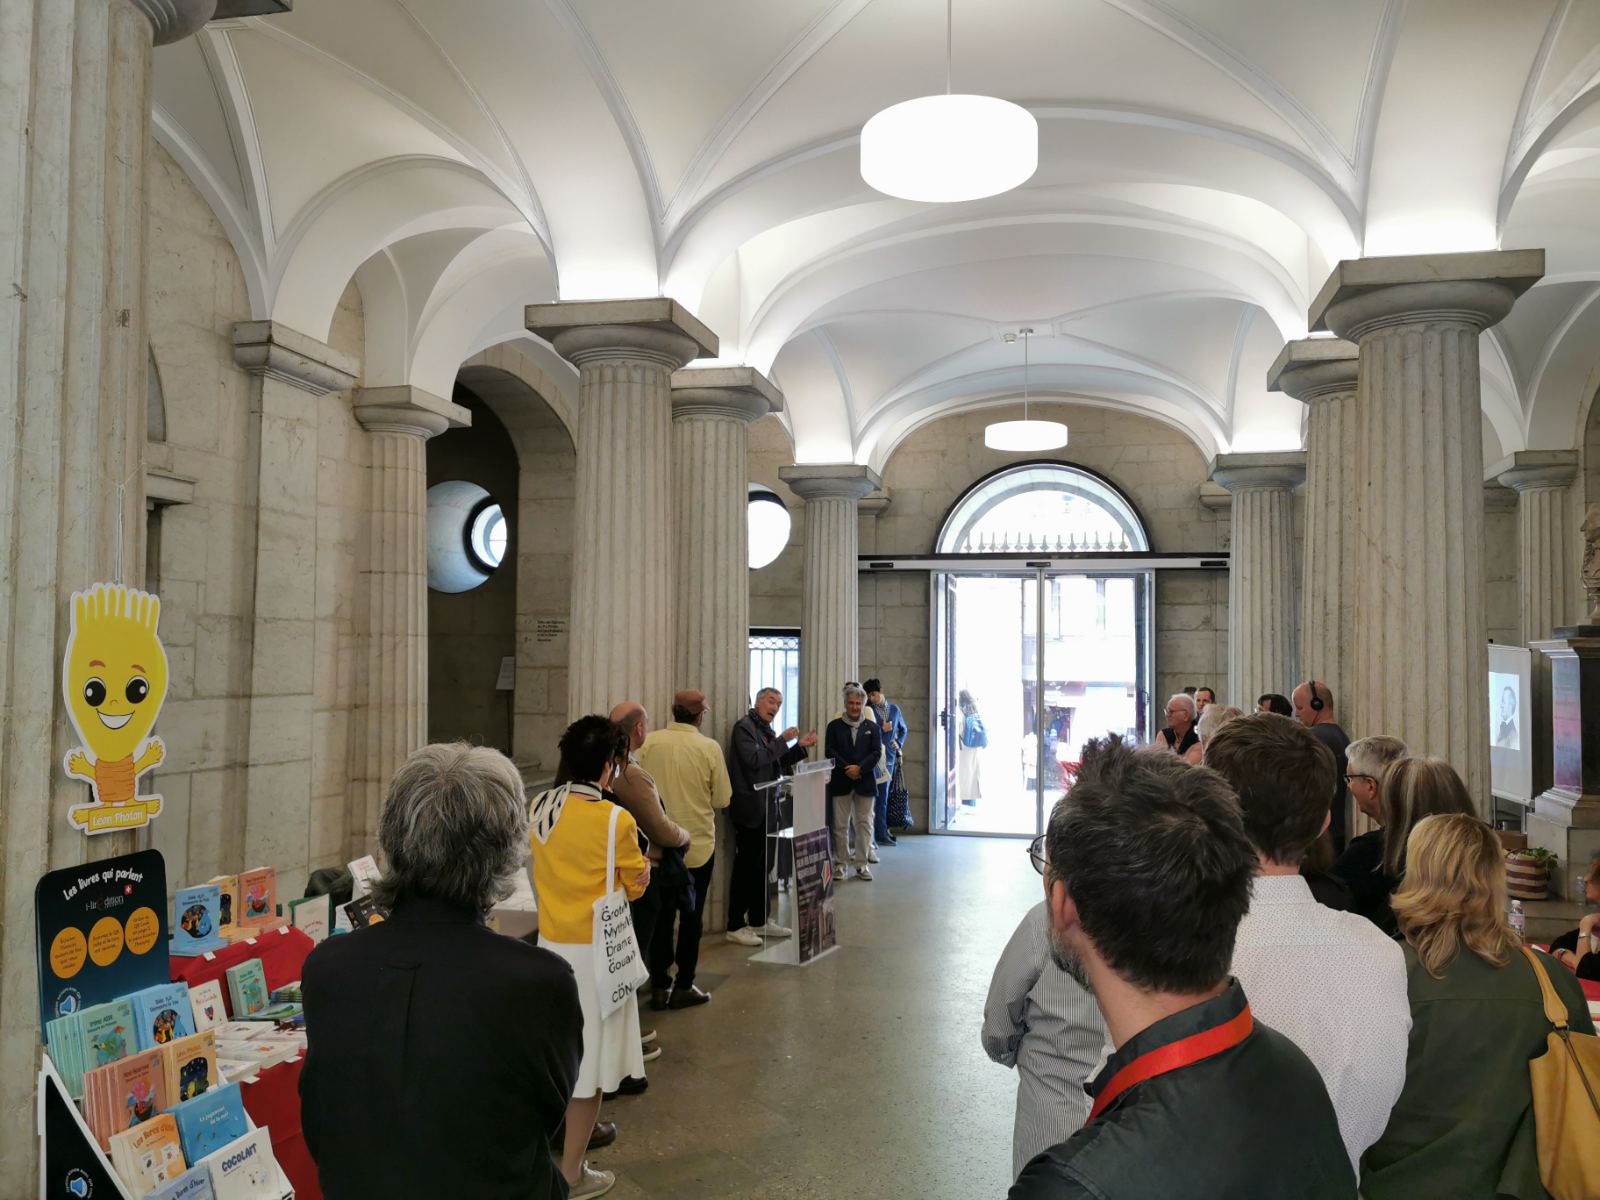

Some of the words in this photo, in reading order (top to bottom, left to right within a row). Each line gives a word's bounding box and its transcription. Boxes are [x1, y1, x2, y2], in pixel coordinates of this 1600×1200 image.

[63, 886, 78, 901] Les
[78, 873, 100, 890] livres
[102, 868, 114, 883] qui
[115, 867, 143, 883] parlent
[222, 1142, 257, 1172] COCOLAIT
